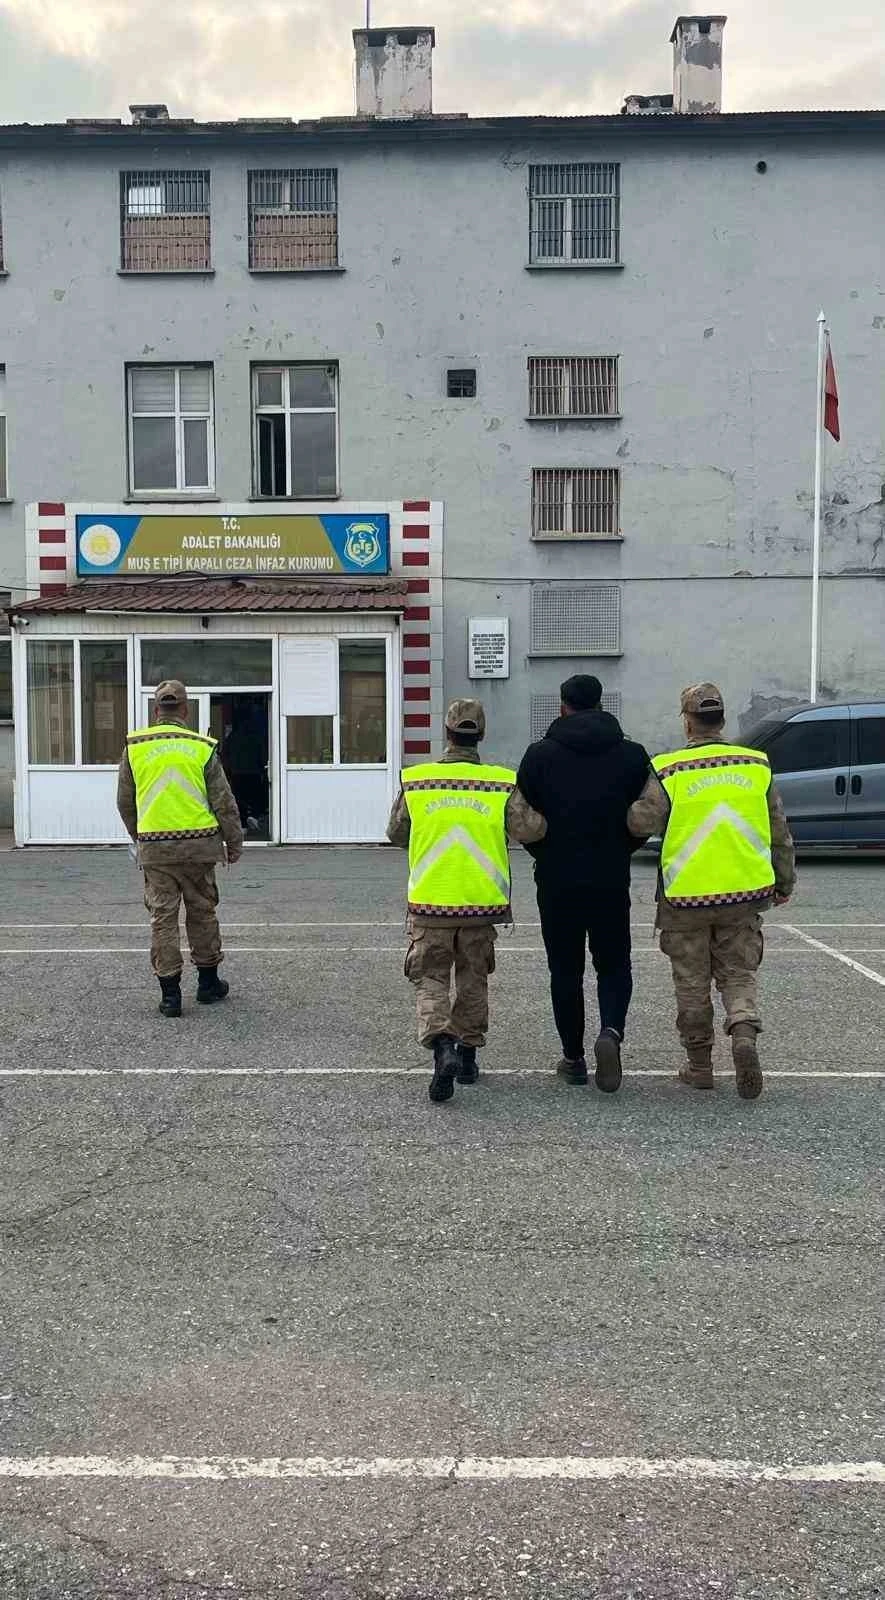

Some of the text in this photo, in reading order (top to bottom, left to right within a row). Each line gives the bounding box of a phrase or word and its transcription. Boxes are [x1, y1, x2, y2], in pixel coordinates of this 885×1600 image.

[221, 517, 241, 531] T.C.
[182, 532, 281, 549] ADALET BAKANLIĞI
[127, 554, 334, 573] MUŞ E TİPİ KAPALI CEZA İNFAZ KURUMU
